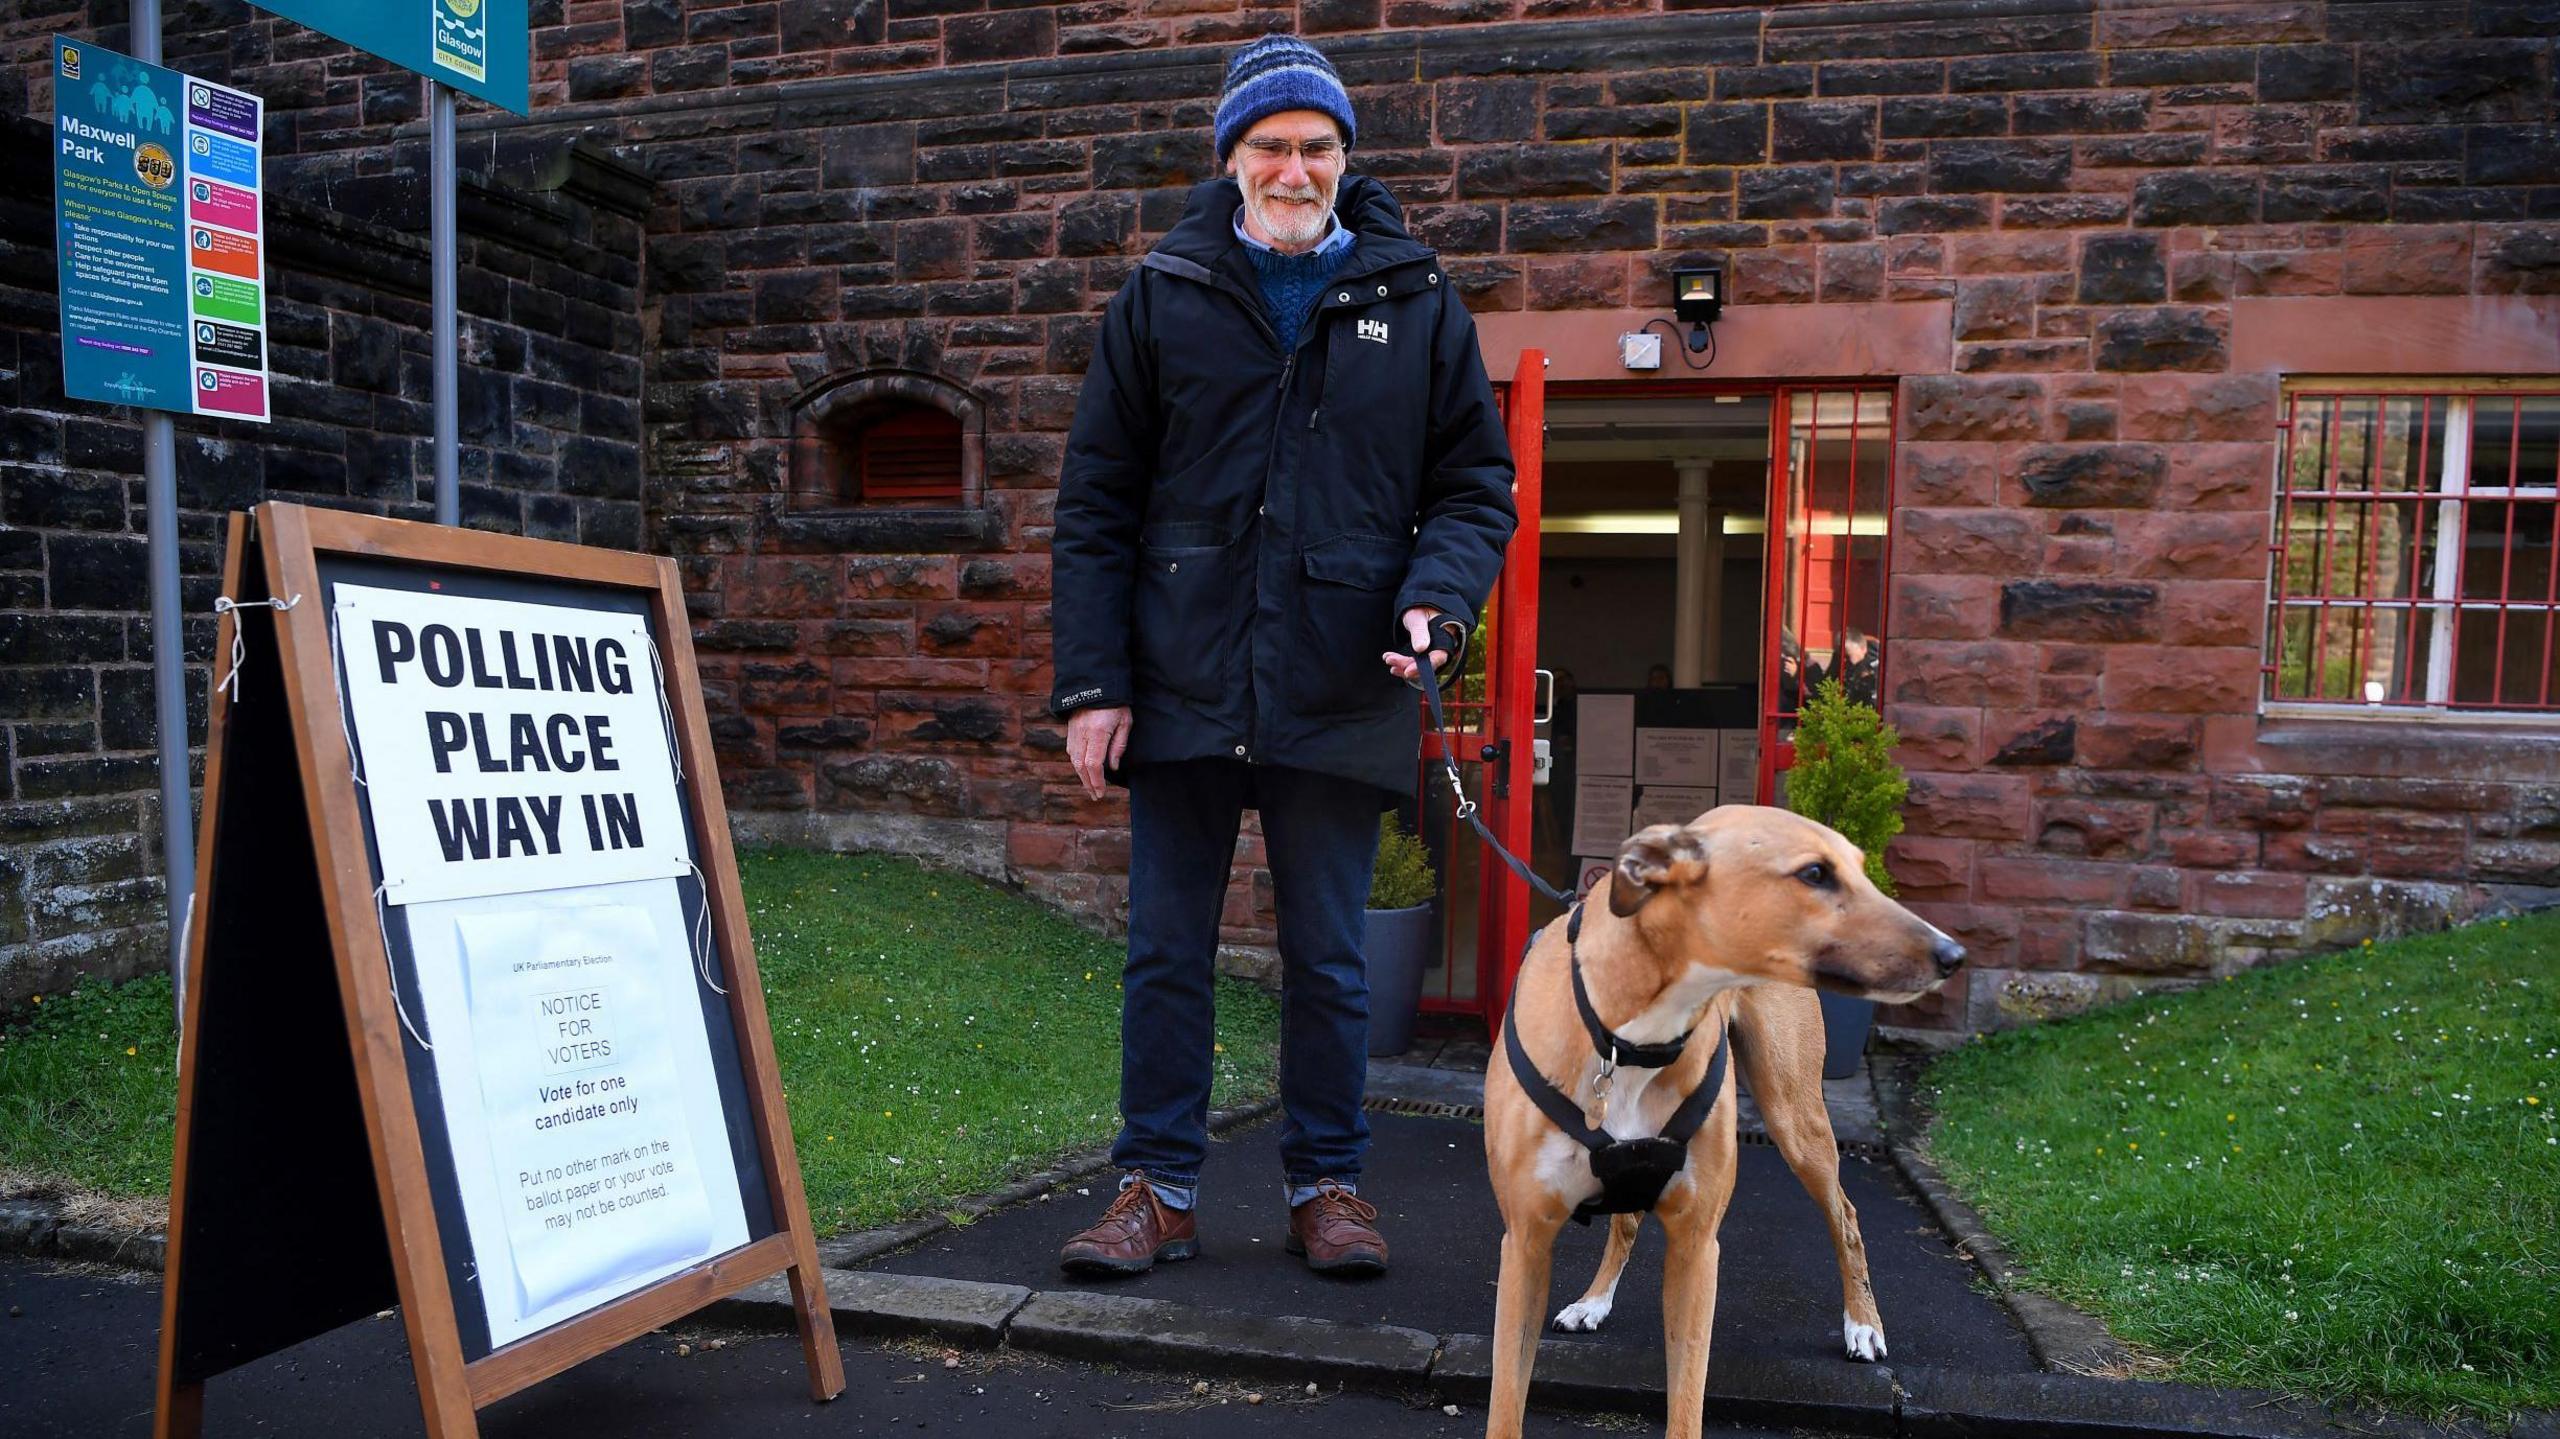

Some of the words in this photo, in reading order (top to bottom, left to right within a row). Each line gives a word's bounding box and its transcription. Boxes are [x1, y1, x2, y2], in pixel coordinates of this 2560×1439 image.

[438, 29, 482, 58] Glasgow
[438, 52, 452, 63] CITY
[455, 59, 480, 75] COUNCIL
[61, 114, 135, 149] Maxwell
[62, 138, 104, 164] Park
[63, 168, 101, 185] Glasgow's
[102, 178, 122, 189] Parks
[124, 183, 129, 191] &
[131, 185, 150, 197] Open
[151, 190, 176, 203] Spaces
[63, 180, 75, 188] are
[76, 182, 87, 191] for
[89, 186, 121, 201] everyone
[123, 193, 130, 201] to
[132, 196, 145, 204] use
[146, 198, 151, 206] &
[64, 198, 85, 210] When
[87, 205, 100, 215] you
[102, 208, 115, 217] use
[116, 210, 152, 227] Glasgow's
[73, 222, 89, 232] Take
[90, 226, 134, 243] responsibility
[135, 236, 144, 244] for
[145, 239, 159, 249] your
[161, 242, 175, 251] own
[73, 231, 98, 243] actions
[74, 241, 102, 254] Respect
[103, 247, 121, 257] other
[122, 251, 144, 263] people
[74, 251, 90, 260] Care
[92, 254, 102, 263] for
[103, 256, 114, 265] the
[115, 259, 154, 273] environment
[75, 261, 90, 271] Help
[92, 264, 125, 277] safeguard
[126, 271, 144, 281] parks
[151, 277, 168, 286] open
[75, 270, 99, 282] spaces
[100, 274, 110, 282] for
[111, 276, 131, 286] future
[132, 281, 169, 295] generations
[1358, 319, 1388, 340] HH
[372, 619, 634, 695] POLLING
[425, 711, 620, 773] PLACE
[427, 795, 562, 862] WAY
[581, 793, 644, 851] IN
[513, 963, 525, 973] UK
[526, 958, 581, 971] Parliamentary
[583, 955, 613, 966] Election
[541, 993, 602, 1016] NOTICE
[559, 1019, 592, 1038] FOR
[547, 1040, 611, 1064] VOTERS
[539, 1087, 572, 1104] Vote
[576, 1080, 595, 1096] for
[600, 1076, 626, 1092] one
[535, 1104, 605, 1130] candidate
[609, 1095, 638, 1114] only
[519, 1170, 543, 1188] Put
[546, 1167, 562, 1183] no
[566, 1159, 597, 1176] other
[601, 1148, 631, 1168] mark
[634, 1145, 648, 1159] on
[651, 1139, 670, 1155] the
[526, 1189, 563, 1211] ballot
[566, 1180, 600, 1203] paper
[604, 1176, 616, 1189] or
[620, 1167, 646, 1188] your
[649, 1161, 674, 1177] vote
[545, 1212, 572, 1230] may
[576, 1203, 597, 1221] not
[599, 1199, 616, 1214] be
[619, 1183, 670, 1209] counted.
